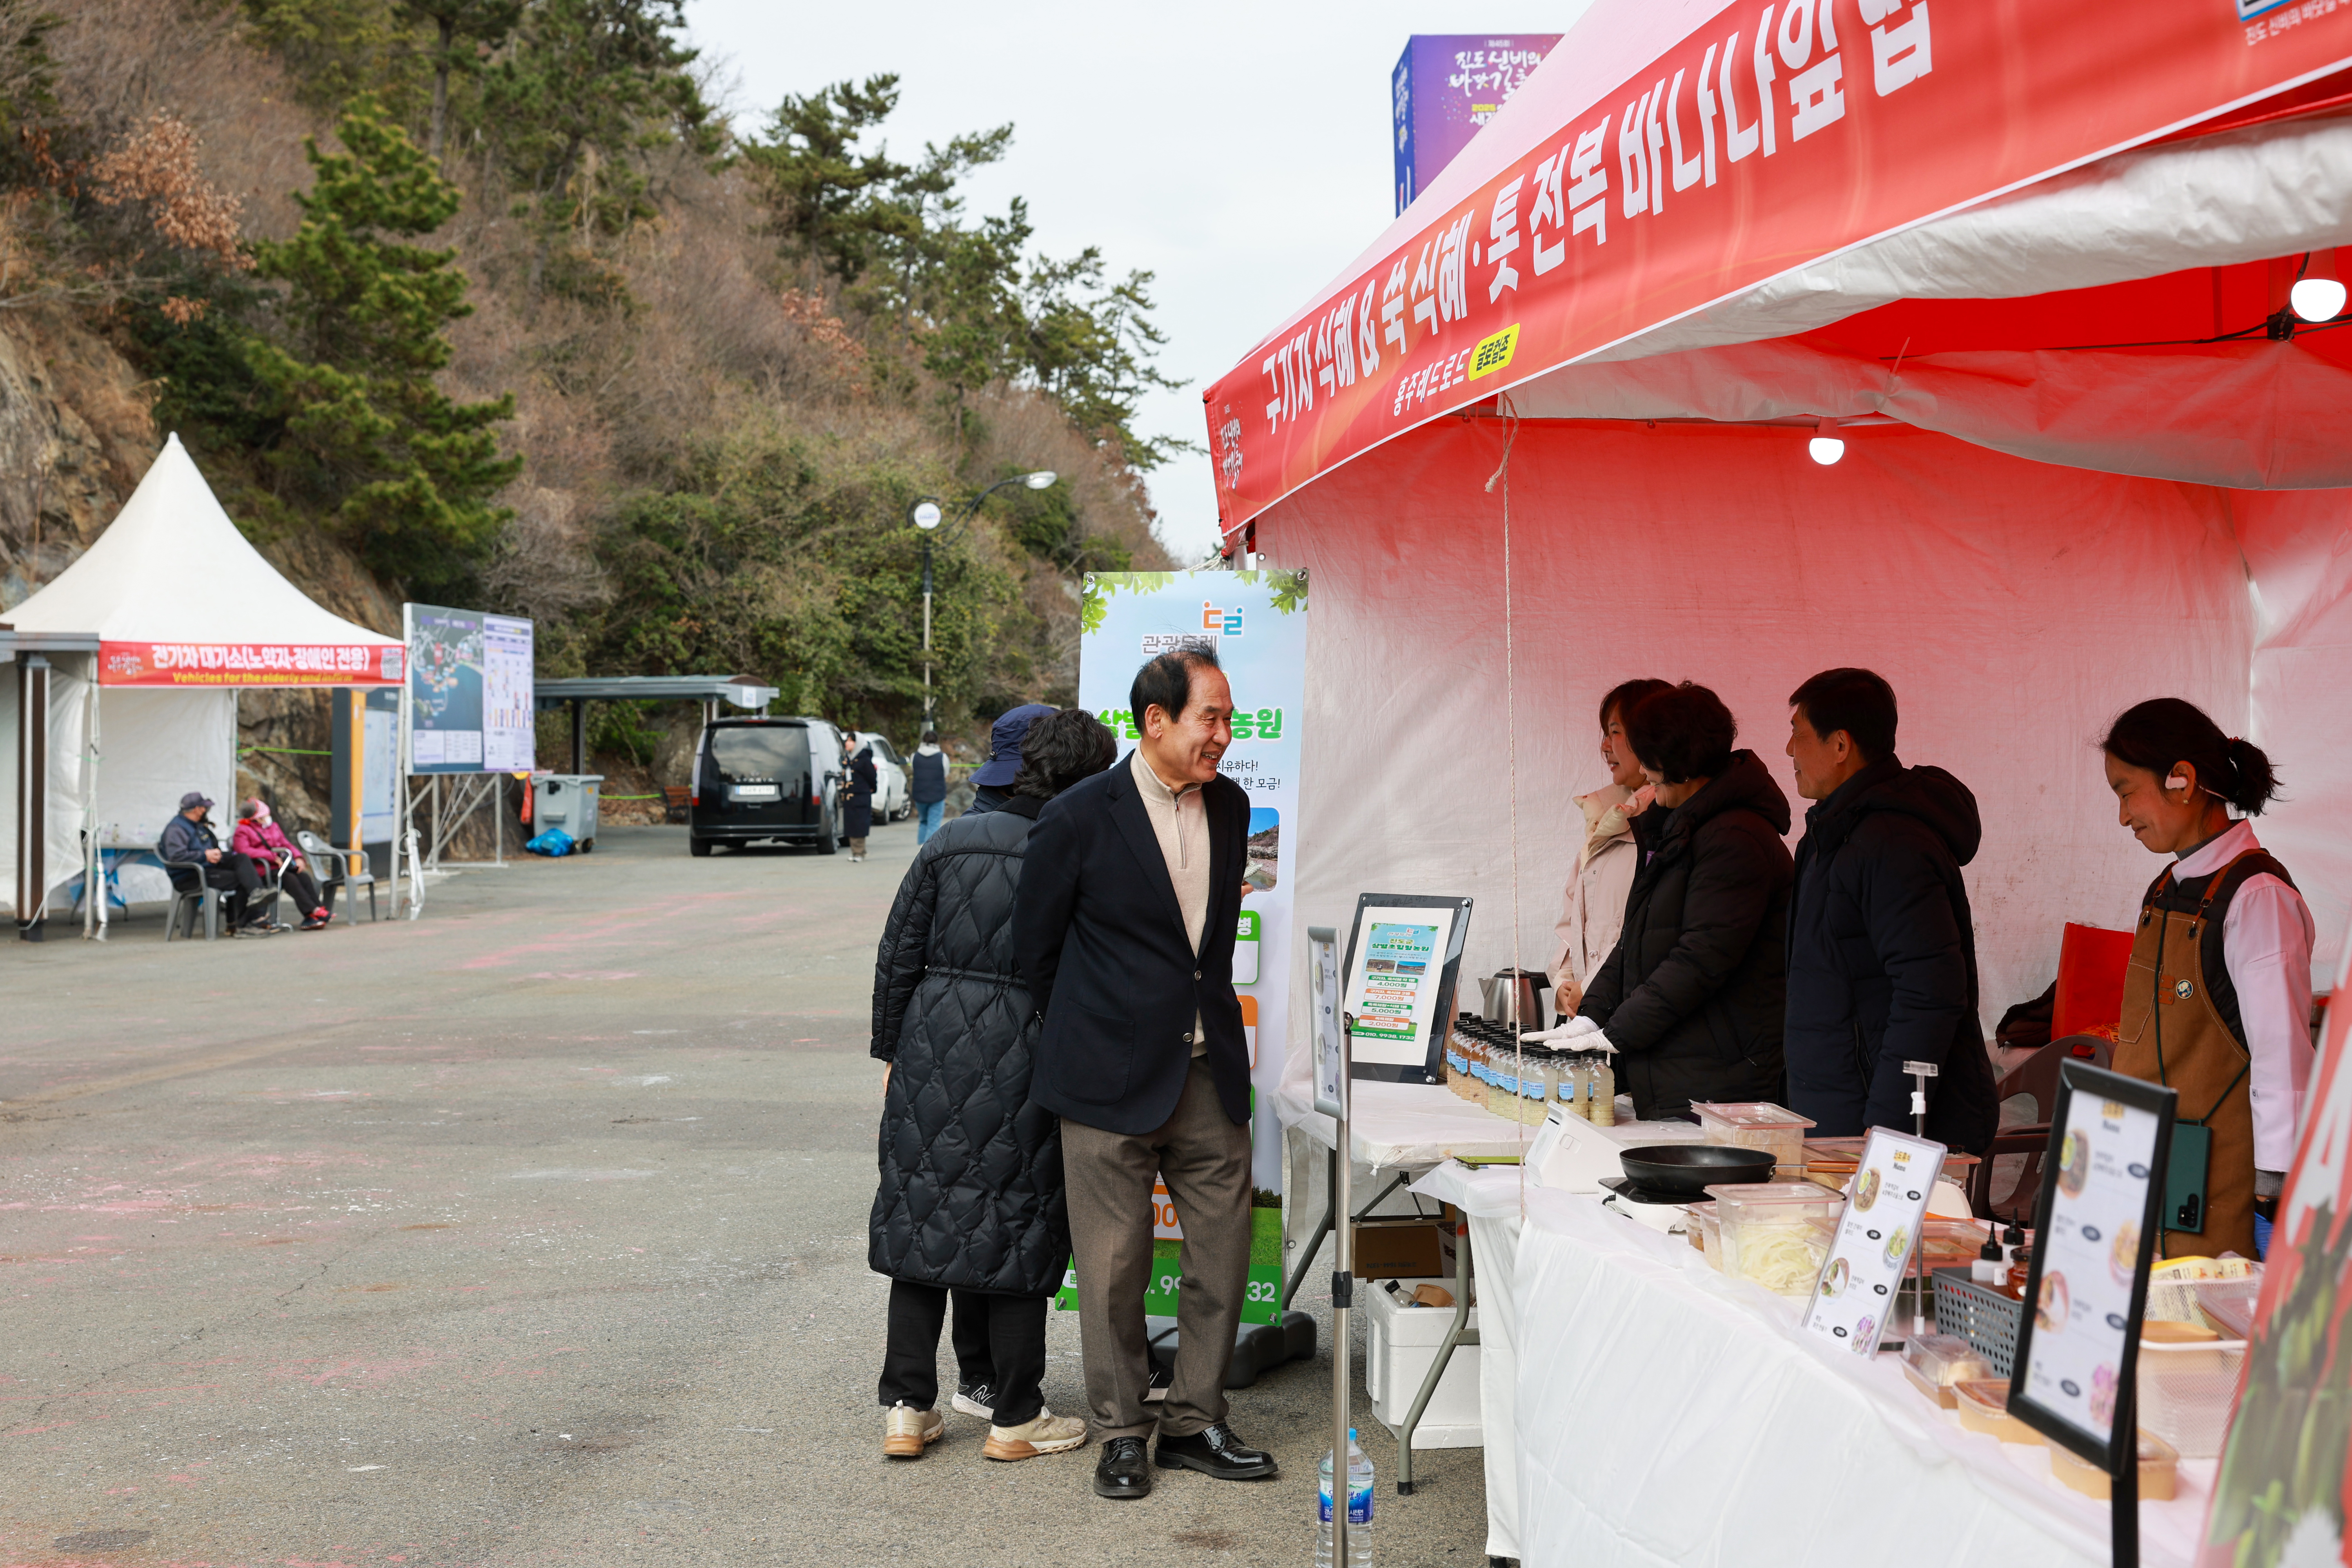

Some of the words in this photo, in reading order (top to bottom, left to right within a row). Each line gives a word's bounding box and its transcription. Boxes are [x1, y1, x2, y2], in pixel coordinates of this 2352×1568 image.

[1454, 50, 1487, 70] 진도
[1488, 49, 1541, 71] 신비의
[1262, 325, 1313, 435] 구기자
[1315, 292, 1357, 397] 식혜
[1359, 279, 1380, 377] &
[1382, 255, 1408, 355] 쑥
[1394, 347, 1471, 417] 홍주레드로드
[1476, 334, 1511, 372] 글로컬존
[336, 646, 370, 671] 전용)
[172, 671, 222, 683] Vehicles
[224, 671, 241, 683] for
[242, 673, 261, 683] the
[262, 673, 299, 684] elderly
[301, 673, 321, 682] and
[1256, 778, 1280, 790] 모금!
[1893, 1162, 1906, 1172] Menu
